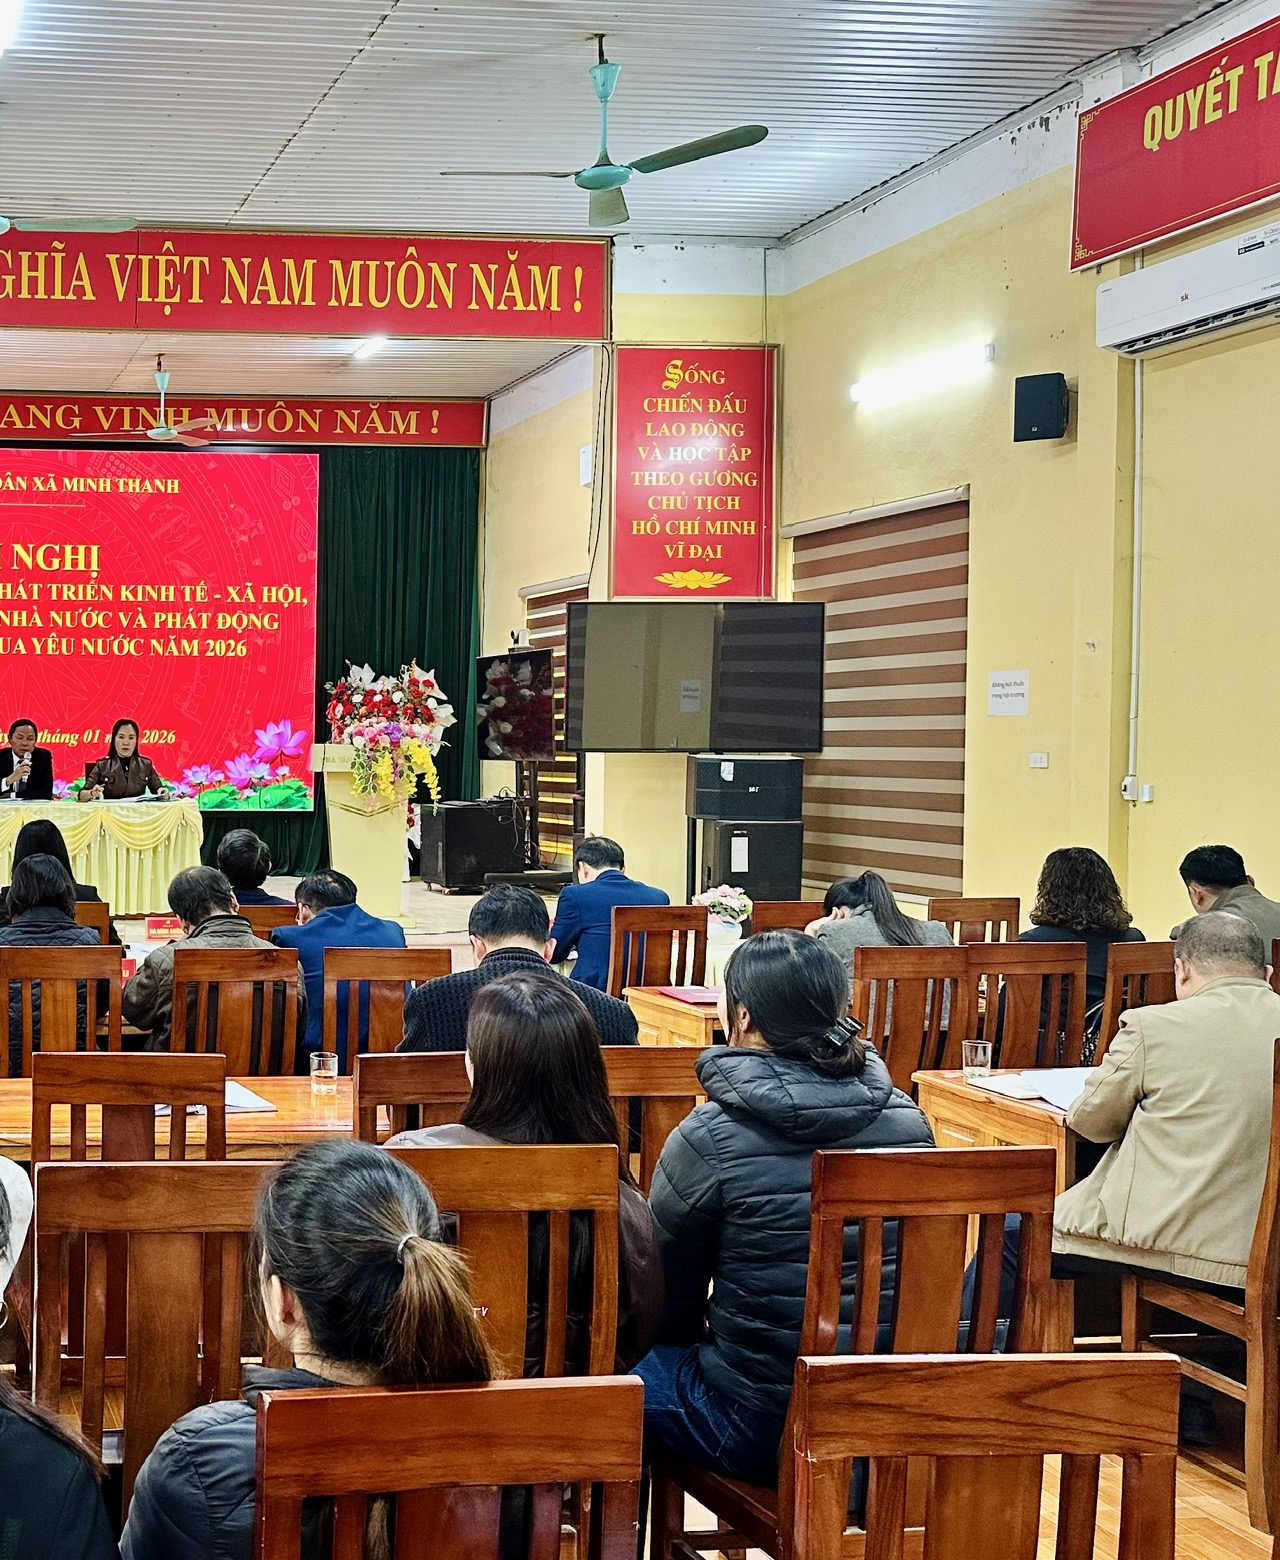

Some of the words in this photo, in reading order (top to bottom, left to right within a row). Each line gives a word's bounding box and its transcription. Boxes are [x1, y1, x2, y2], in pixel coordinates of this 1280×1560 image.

[1143, 56, 1244, 152] QUYẾT
[1254, 44, 1280, 102] T
[106, 241, 210, 316] VIỆT
[220, 256, 317, 307] NAM
[328, 246, 457, 310] MUÔN
[467, 249, 563, 312] NĂM
[662, 359, 726, 390] SỐNG
[643, 391, 702, 414] CHIẾN
[707, 391, 747, 414] ĐẤU
[92, 405, 192, 432] VINH
[204, 401, 323, 434] MUÔN
[333, 402, 421, 436] NĂM
[646, 422, 686, 437] LAO
[690, 419, 745, 441] ĐỘNG
[638, 441, 663, 461] VÀ
[669, 446, 710, 464] HỌC
[714, 443, 752, 465] TẬP
[33, 473, 58, 492] XÃ
[62, 477, 112, 492] MINH
[116, 478, 180, 494] THANH
[631, 471, 684, 486] THEO
[689, 469, 758, 487] GƯƠNG
[648, 491, 688, 510] CHỦ
[694, 495, 740, 512] TỊCH
[631, 513, 661, 535] HỒ
[665, 515, 699, 535] CHÍ
[704, 520, 756, 535] MINH
[11, 543, 101, 578] NGHỊ
[664, 541, 684, 559] VĨ
[688, 544, 723, 562] ĐẠI
[120, 585, 175, 602] KINH
[181, 580, 209, 602] TẾ
[226, 582, 256, 603] XÃ
[262, 584, 308, 608] HỘI,
[49, 608, 113, 629] NƯỚC
[119, 607, 148, 629] VÀ
[154, 607, 212, 630] PHÁT
[217, 611, 279, 634] ĐỘNG
[33, 633, 75, 656] YÊU
[81, 637, 144, 656] NƯỚC
[149, 636, 199, 657] NĂM
[205, 639, 247, 657] 2026
[37, 728, 79, 746] tháng
[83, 729, 100, 744] 01
[142, 729, 176, 744] 2026
